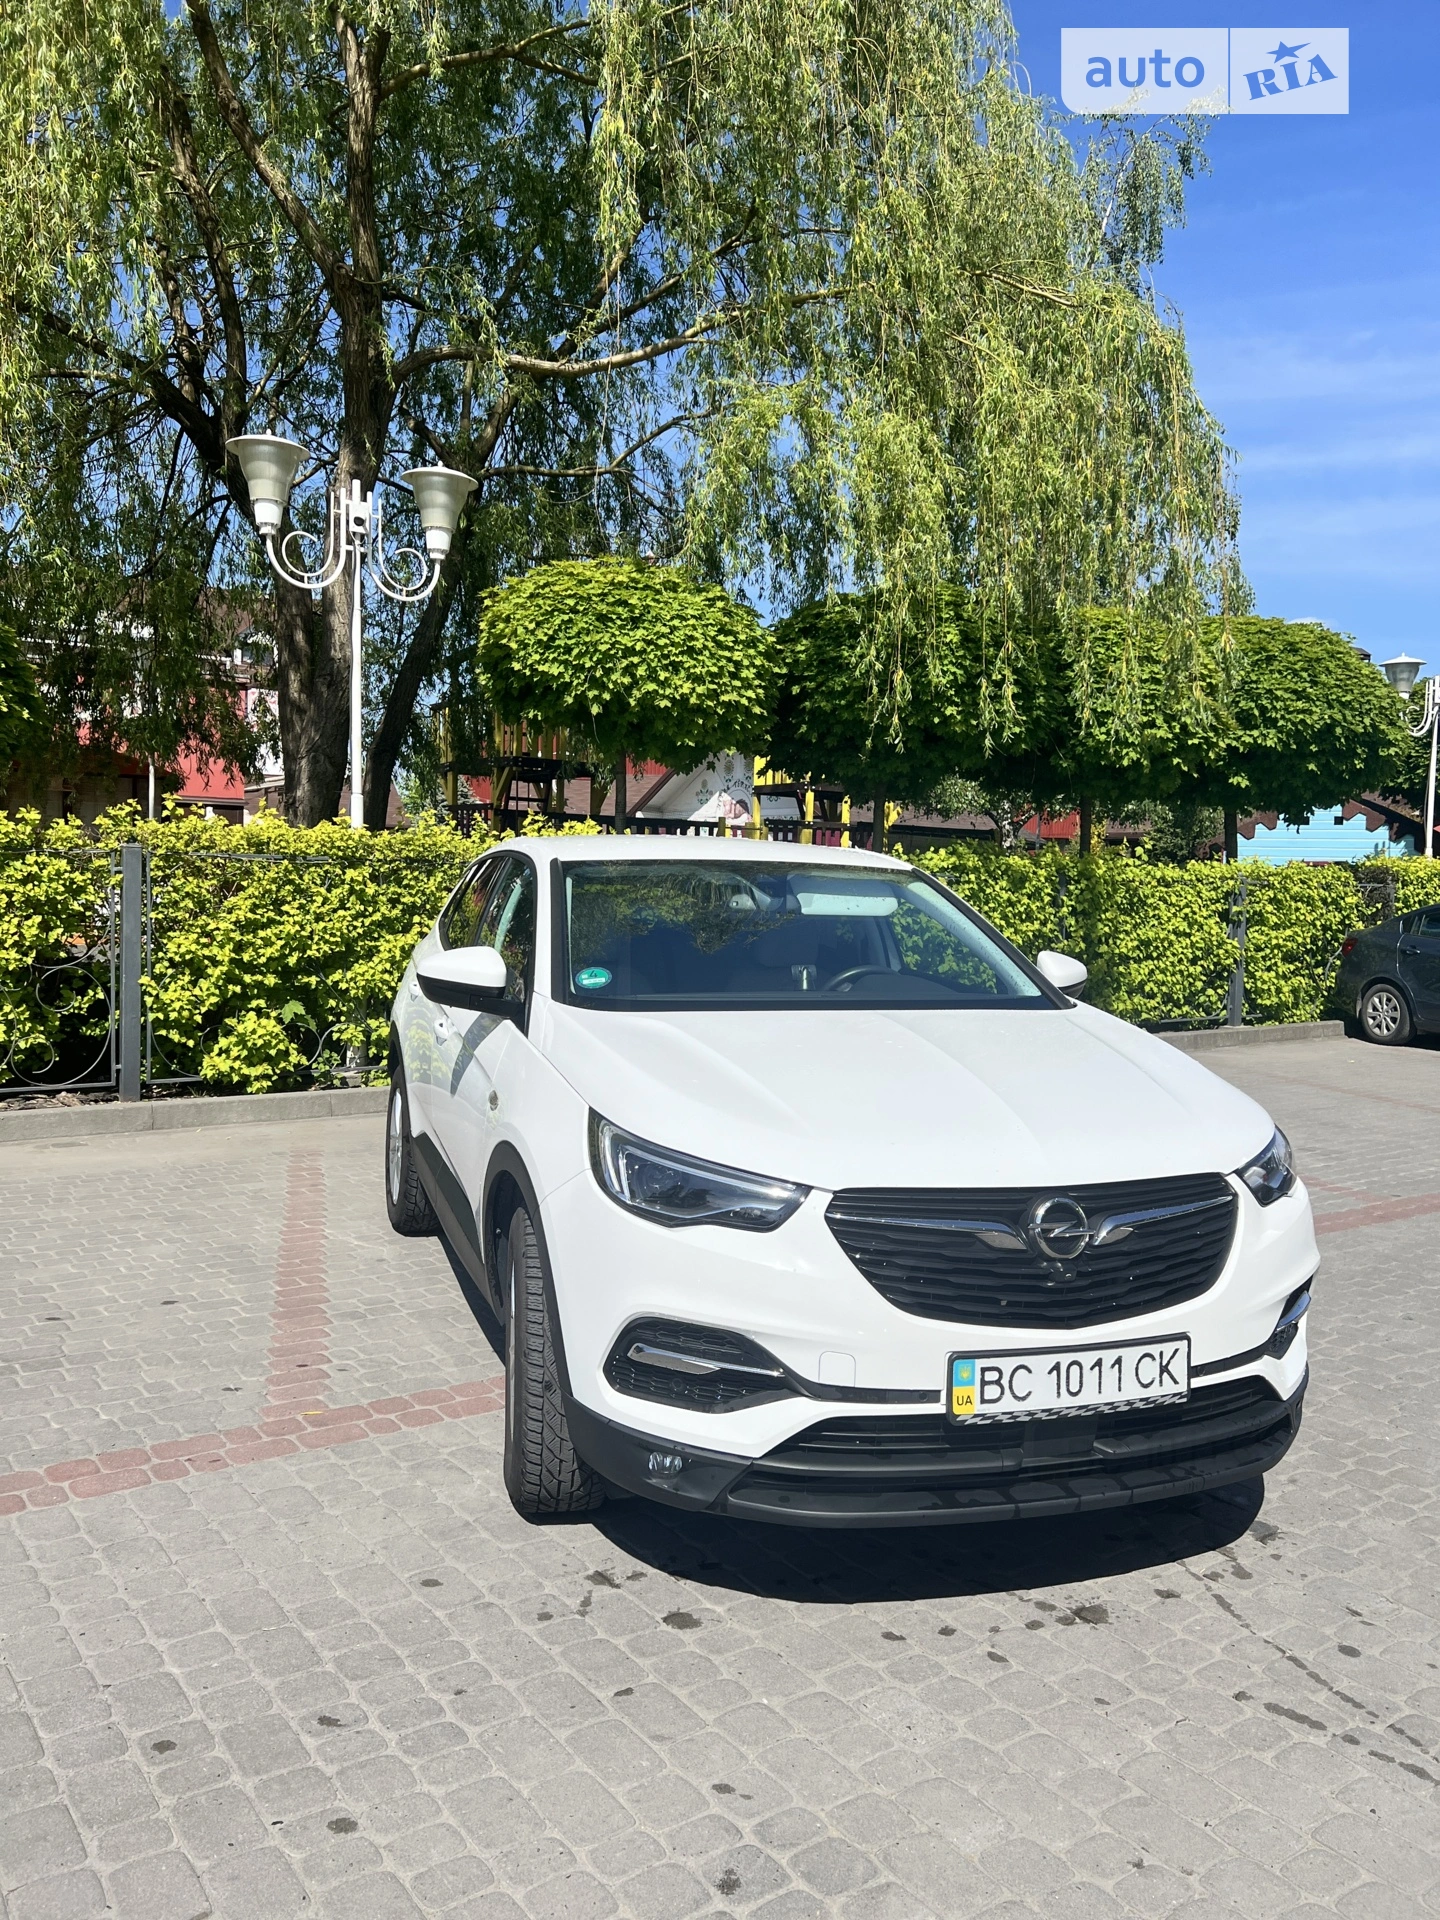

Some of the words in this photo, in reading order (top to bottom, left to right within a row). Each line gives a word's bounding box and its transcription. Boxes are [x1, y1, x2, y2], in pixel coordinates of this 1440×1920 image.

[979, 1364, 1033, 1405] BC
[1047, 1355, 1124, 1399] 1011
[1134, 1347, 1180, 1389] CK
[956, 1394, 973, 1406] UA
